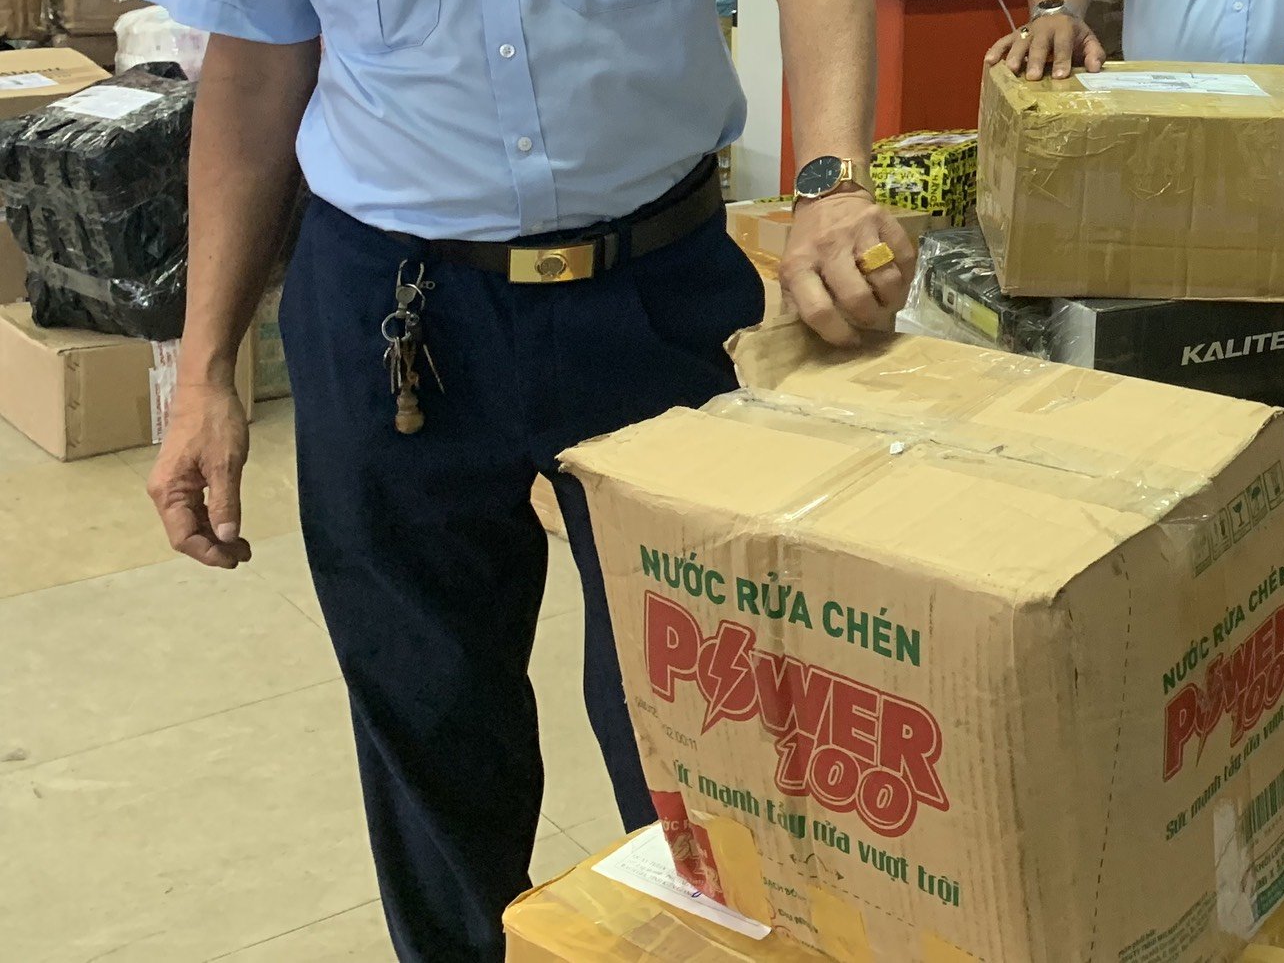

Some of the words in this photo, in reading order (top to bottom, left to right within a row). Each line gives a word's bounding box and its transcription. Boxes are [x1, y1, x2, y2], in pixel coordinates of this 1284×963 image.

[640, 544, 726, 605] NƯỚC
[736, 572, 813, 630] RỬA
[822, 600, 921, 667] CHÉN
[1162, 636, 1209, 695] NƯỚC
[1213, 604, 1246, 648] RỬA
[644, 590, 949, 812] POWER
[698, 773, 760, 817] mạnh
[858, 840, 909, 885] vượt
[917, 862, 960, 907] trội
[774, 730, 917, 838] 100
